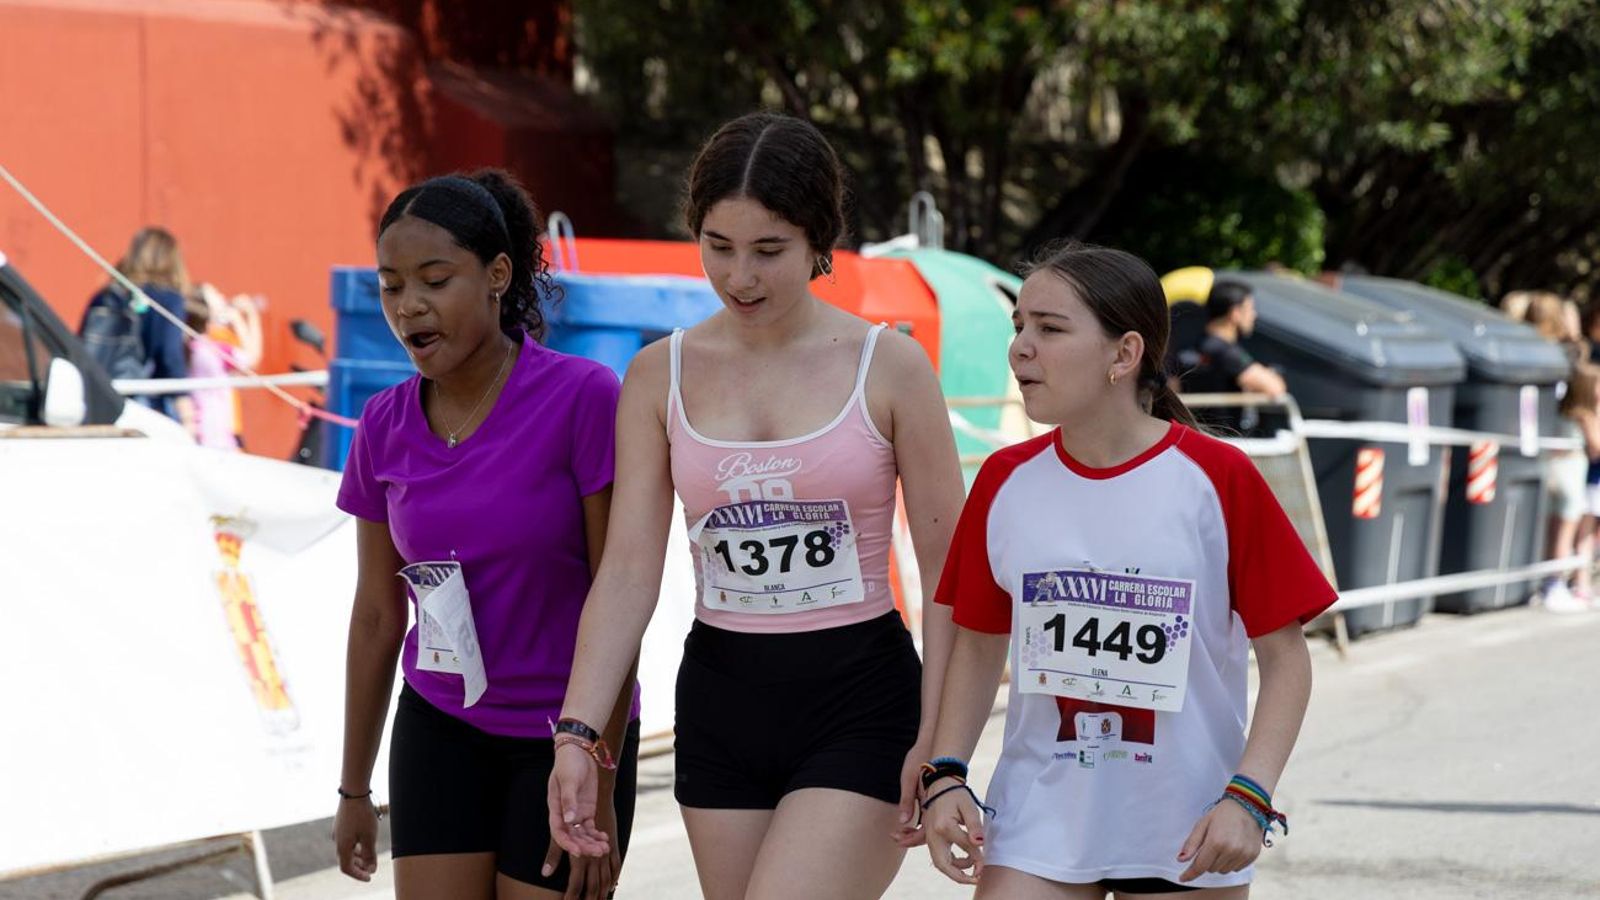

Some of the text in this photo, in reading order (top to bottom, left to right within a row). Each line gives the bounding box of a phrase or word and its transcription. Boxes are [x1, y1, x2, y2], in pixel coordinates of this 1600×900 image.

[715, 452, 802, 481] Boston
[712, 502, 764, 526] XXXVI
[764, 503, 840, 513] CARRERA ESCOLAR
[773, 512, 830, 521] LA GLORIA
[713, 530, 836, 576] 1378
[763, 583, 786, 591] BLANCA
[1055, 575, 1108, 602] XXXVI
[1108, 580, 1186, 599] CARRERA ESCOLAR
[1114, 591, 1174, 609] LA GLORIA
[1043, 613, 1168, 665] 1449
[1091, 667, 1109, 678] ELENA
